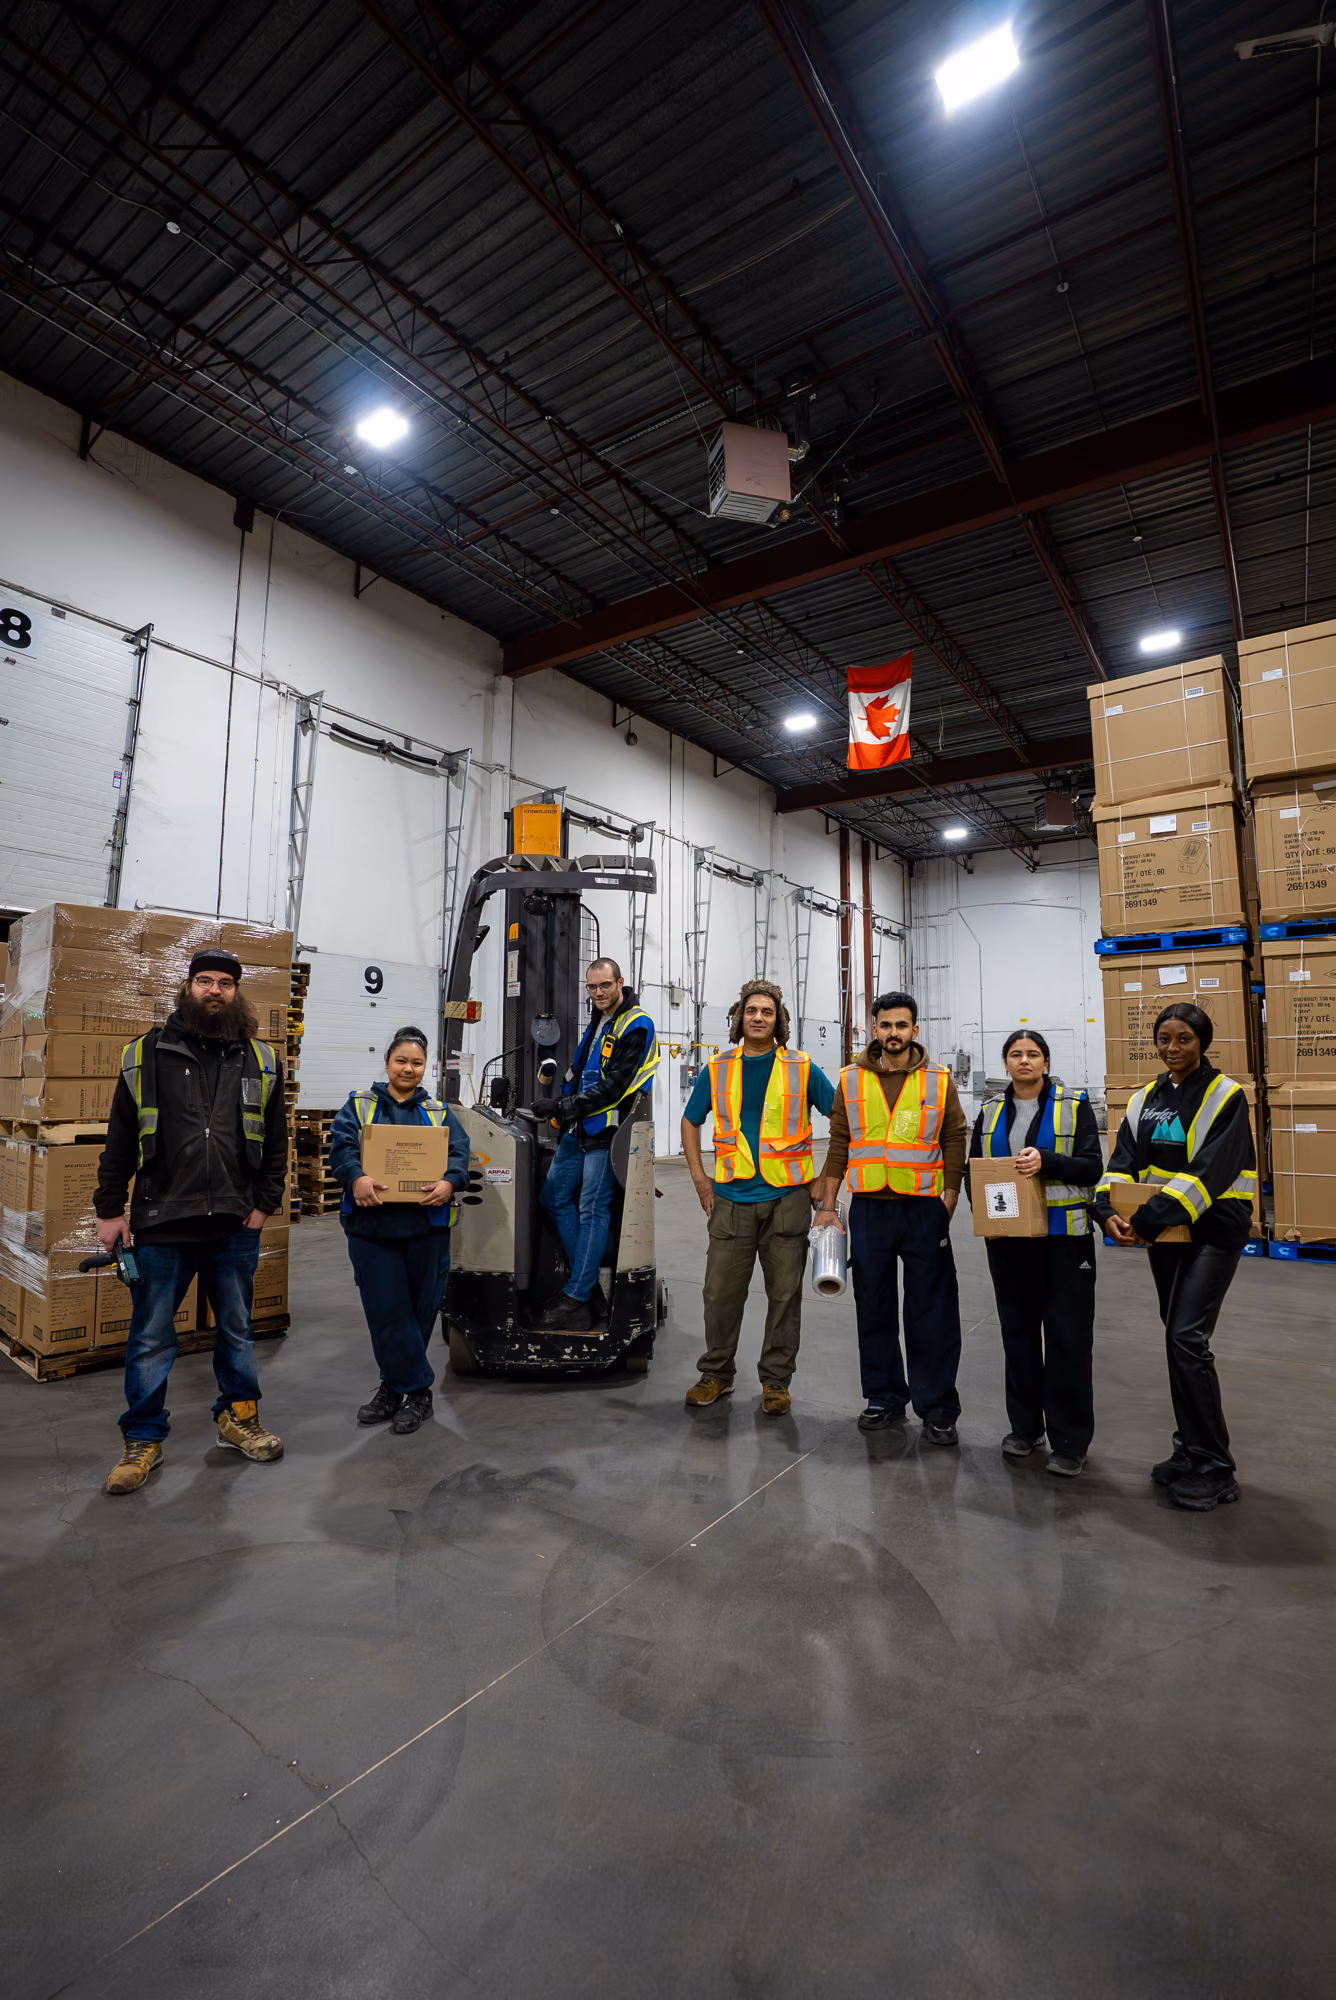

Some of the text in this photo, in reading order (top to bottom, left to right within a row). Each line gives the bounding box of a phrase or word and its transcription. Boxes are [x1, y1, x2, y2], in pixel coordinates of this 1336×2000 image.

[0, 608, 31, 648] 8
[1285, 851, 1299, 859] QTY
[1156, 868, 1165, 876] 60
[1286, 880, 1327, 891] 2691349
[1125, 898, 1157, 908] 2691349
[365, 966, 383, 994] 9
[1316, 1014, 1330, 1022] QTÉ
[819, 1026, 826, 1038] 12
[1297, 1048, 1336, 1056] 2691349
[1141, 1108, 1178, 1123] Vertex
